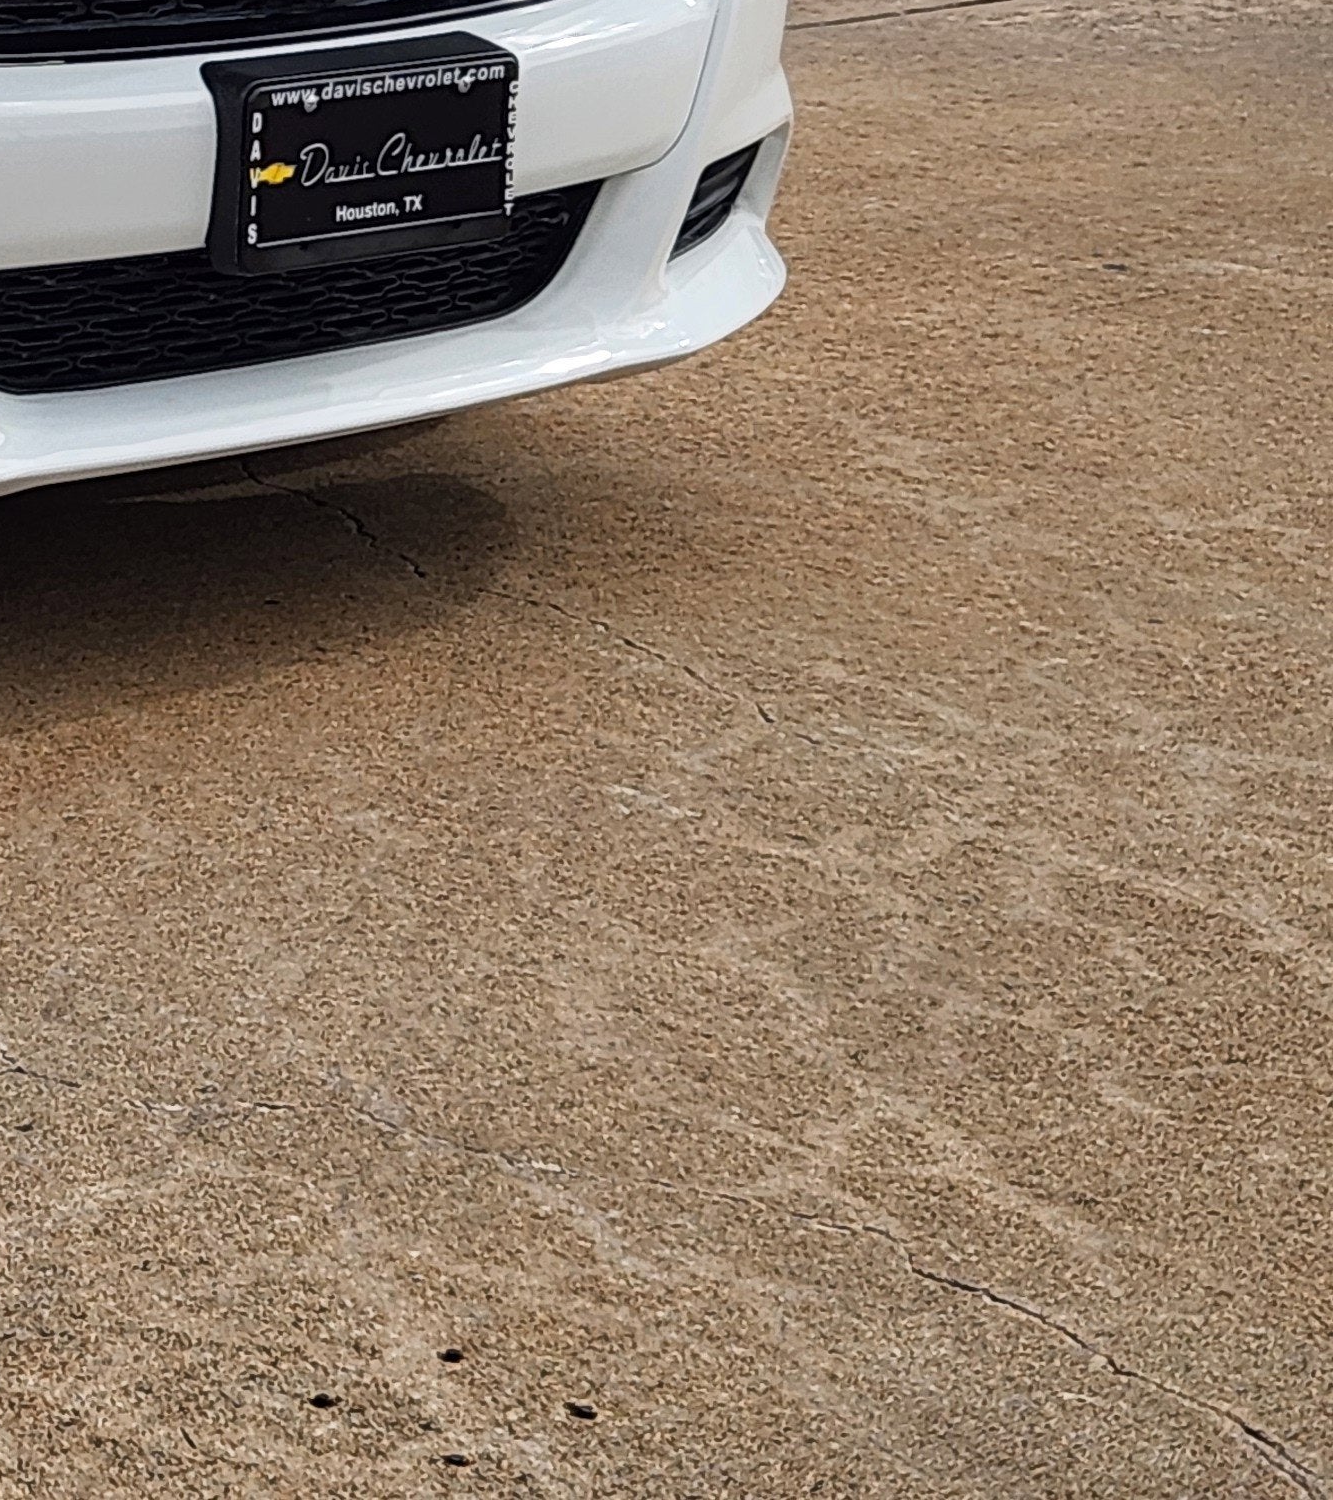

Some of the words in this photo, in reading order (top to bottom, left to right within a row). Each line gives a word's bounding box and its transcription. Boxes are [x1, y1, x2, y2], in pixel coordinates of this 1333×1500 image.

[247, 112, 263, 245] DAVIS
[300, 143, 376, 187] Davis
[377, 132, 503, 176] Chevrolet
[335, 200, 401, 223] Houston,
[403, 194, 423, 213] TX
